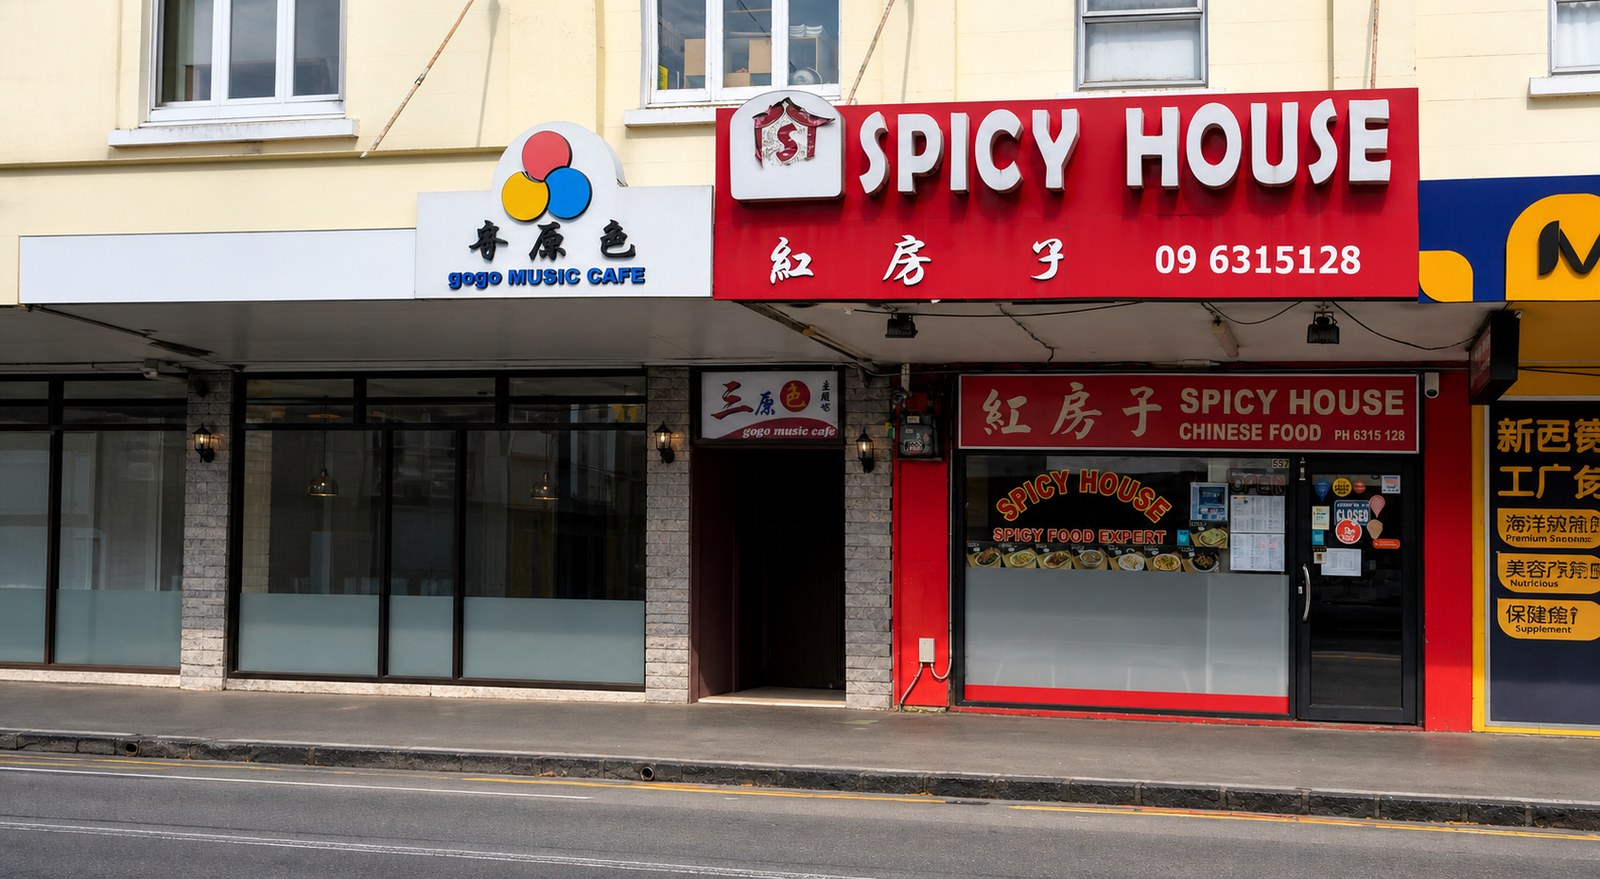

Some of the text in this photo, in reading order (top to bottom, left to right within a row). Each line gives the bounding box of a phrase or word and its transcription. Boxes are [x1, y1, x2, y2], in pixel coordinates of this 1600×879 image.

[858, 98, 1392, 196] SPICY HOUSE
[769, 234, 1065, 286] 紅房子
[1155, 245, 1362, 275] 09 6315128
[448, 267, 646, 290] gogo MUSIC CAFE
[982, 381, 1163, 440] 紅房子
[1179, 387, 1405, 416] SPICY HOUSE
[742, 426, 836, 438] gogo music cafe
[1179, 422, 1322, 442] CHINESE FOOD
[1334, 429, 1405, 441] PH 6315 128
[996, 469, 1069, 522] SPICY
[1079, 468, 1173, 524] HOUSE
[993, 527, 1166, 545] SPICY FOOD EXPERT
[1505, 535, 1547, 543] Premium
[1515, 624, 1571, 635] Supplement
